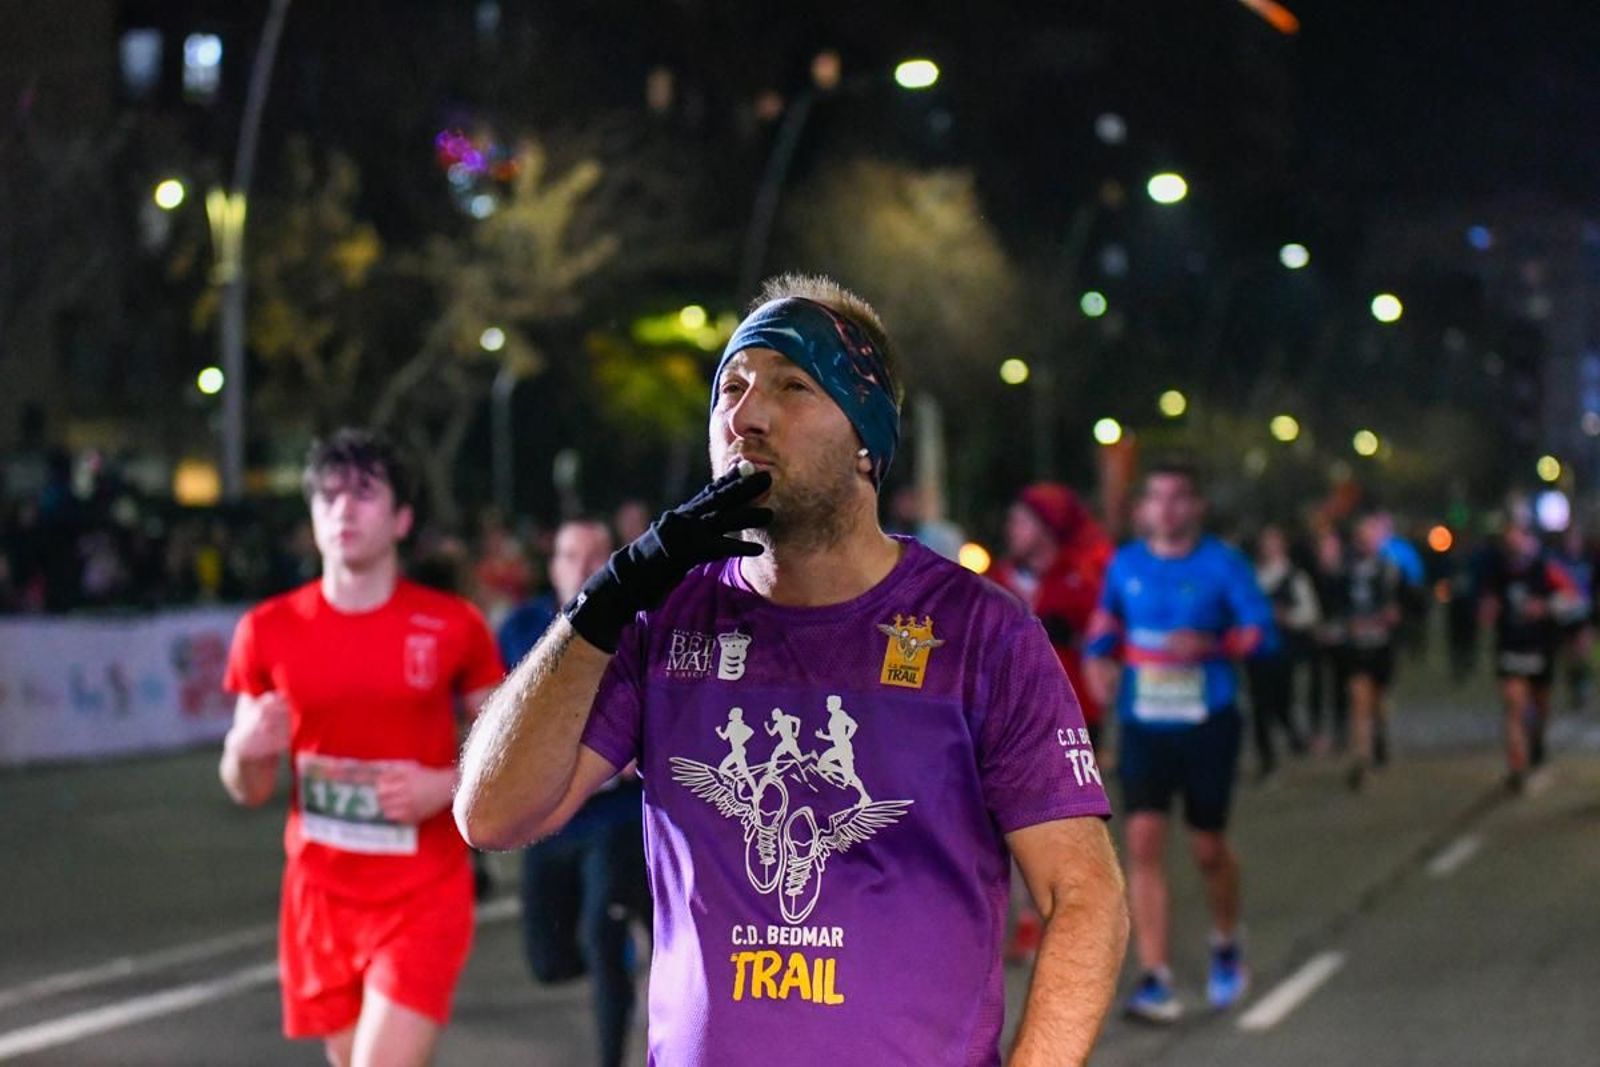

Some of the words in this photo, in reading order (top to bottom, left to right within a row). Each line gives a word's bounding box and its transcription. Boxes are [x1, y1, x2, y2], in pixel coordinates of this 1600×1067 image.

[888, 668, 918, 685] TRAIL
[1057, 728, 1080, 746] C.D.
[1065, 748, 1102, 786] TR
[731, 925, 764, 945] C.D.
[767, 925, 844, 947] BEDMAR
[730, 950, 845, 1004] TRAIL
